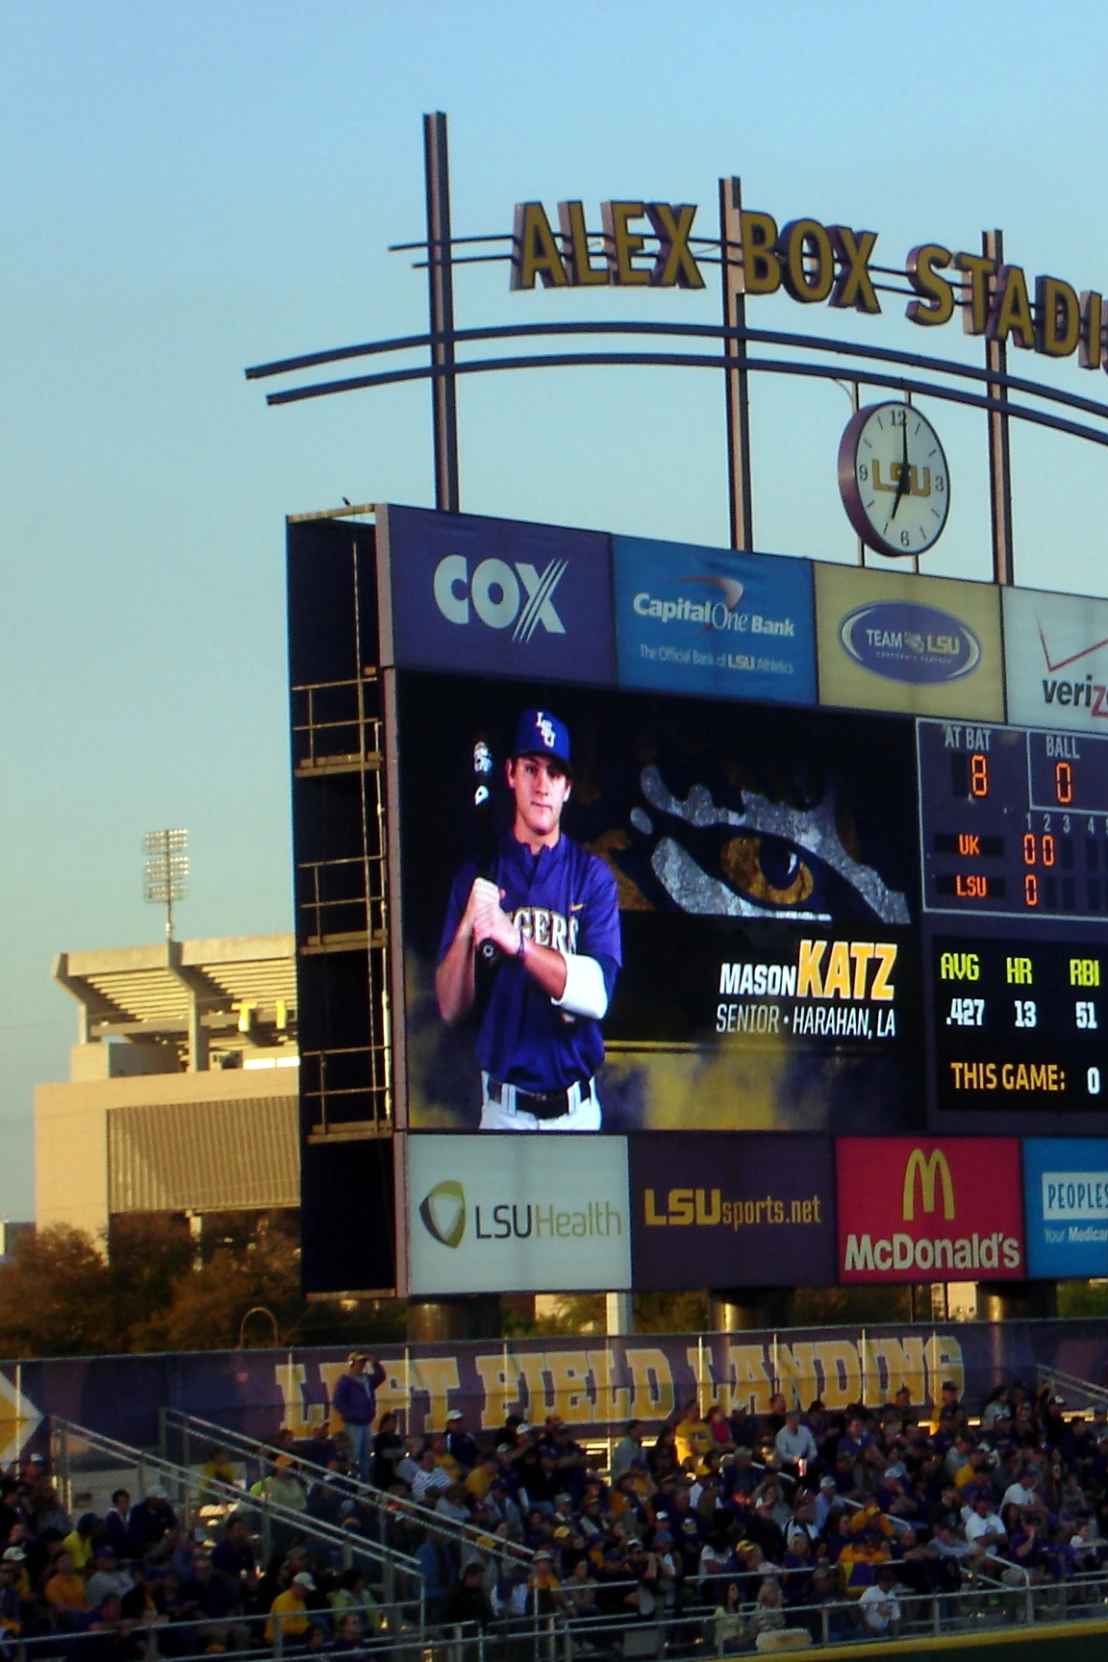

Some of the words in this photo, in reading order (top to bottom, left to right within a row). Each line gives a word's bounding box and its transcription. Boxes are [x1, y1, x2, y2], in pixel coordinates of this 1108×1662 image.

[510, 201, 706, 292] ALEX
[741, 209, 882, 314] BOX
[859, 464, 868, 482] 9
[935, 475, 944, 493] 3
[901, 530, 909, 547] 6
[434, 554, 569, 643] COX
[751, 615, 795, 637] Bank
[866, 629, 902, 649] TEAM
[927, 634, 960, 655] LSU
[640, 643, 656, 659] The
[658, 644, 690, 663] Official
[728, 653, 755, 671] LSU
[535, 711, 557, 748] LSU
[945, 728, 961, 749] AT
[966, 729, 991, 751] BAT
[1046, 735, 1080, 760] BALL
[971, 755, 988, 797] 8
[1056, 762, 1072, 803] 0
[1026, 813, 1033, 830] 1
[1043, 814, 1051, 832] 2
[1063, 815, 1071, 833] 3
[1088, 817, 1096, 835] 4
[959, 834, 980, 856] UK
[956, 876, 987, 898] LSU
[1025, 874, 1038, 906] 0
[719, 963, 796, 997] MASON
[797, 939, 898, 1001] KATZ
[941, 952, 979, 981] AVG
[1006, 957, 1033, 985] HR
[1070, 959, 1100, 987] RBI
[716, 1004, 780, 1034] SENIOR
[793, 1006, 872, 1039] HARAHAN,
[877, 1009, 896, 1037] LA
[946, 998, 985, 1027] .427
[1014, 1001, 1037, 1029] 13
[1075, 1001, 1098, 1030] 51
[950, 1062, 997, 1090] THIS
[1001, 1064, 1066, 1092] GAME:
[1087, 1067, 1100, 1095] 0
[644, 1188, 821, 1231] LSUsports.net
[1044, 1227, 1066, 1243] Your
[845, 1232, 1020, 1271] McDonald's
[475, 1347, 675, 1430] FIELD
[686, 1336, 965, 1418] LANDING
